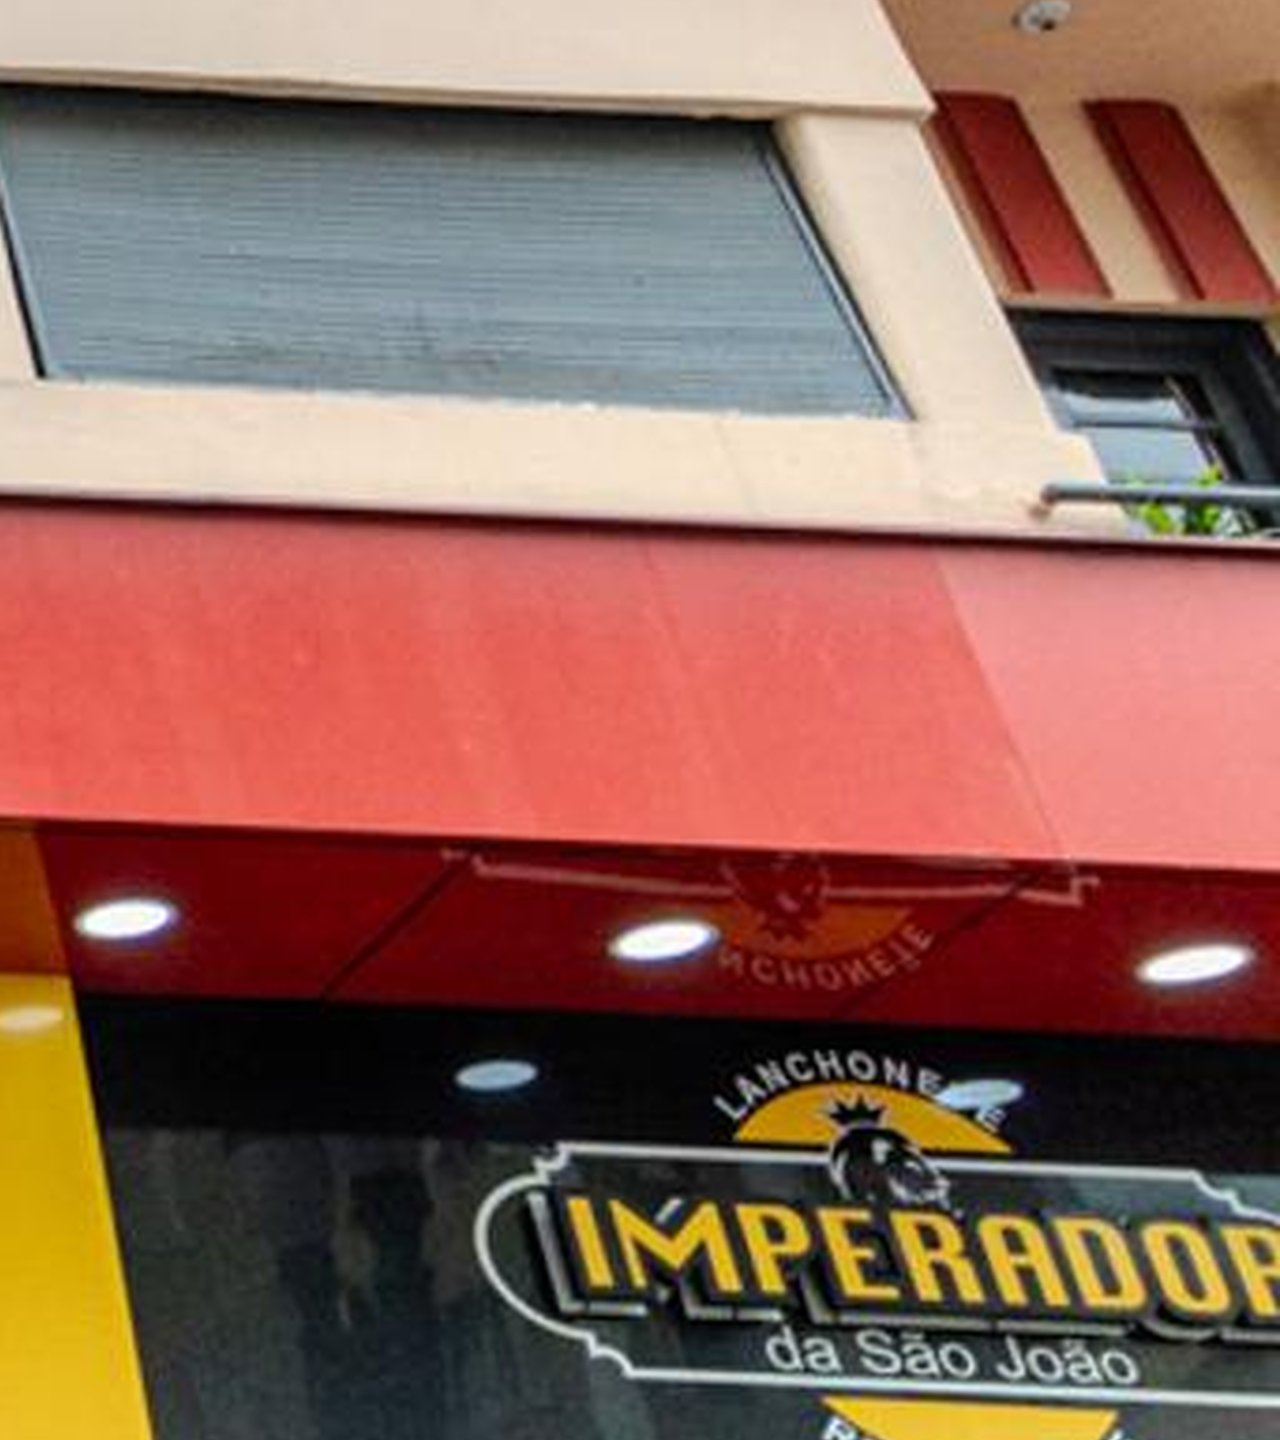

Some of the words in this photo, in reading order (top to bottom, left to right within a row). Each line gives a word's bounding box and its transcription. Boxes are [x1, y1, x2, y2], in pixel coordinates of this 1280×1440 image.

[714, 1050, 1006, 1133] LANCHONEE
[564, 1194, 1280, 1318] IMPERADOR
[765, 1326, 841, 1372] da
[856, 1328, 976, 1378] São
[996, 1336, 1140, 1386] João
